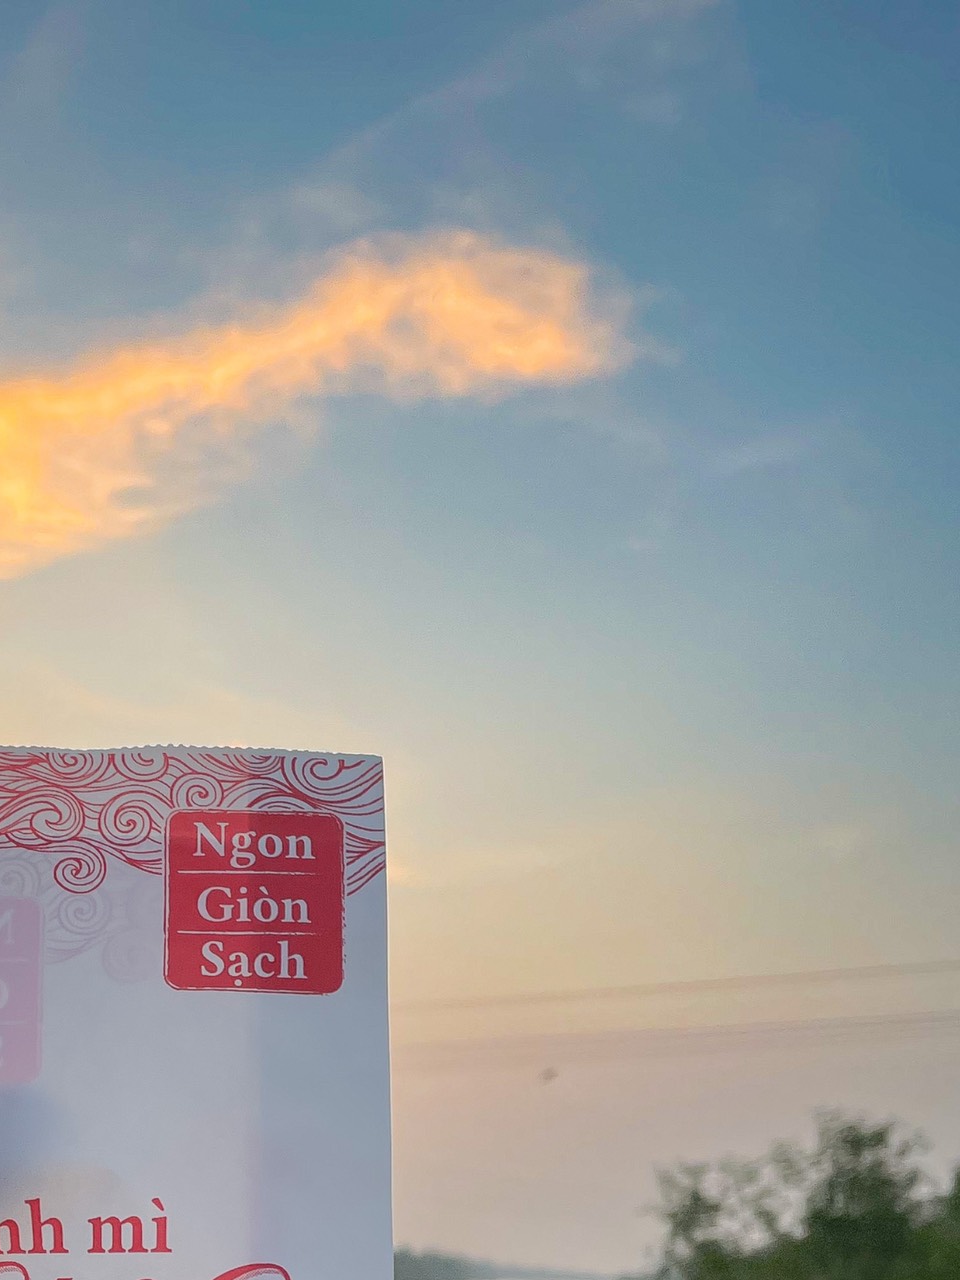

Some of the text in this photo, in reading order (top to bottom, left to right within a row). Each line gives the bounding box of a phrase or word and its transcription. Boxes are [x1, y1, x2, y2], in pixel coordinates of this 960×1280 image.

[193, 821, 316, 869] Ngon
[197, 886, 312, 924] Giòn
[200, 940, 308, 987] Sạch
[87, 1197, 173, 1254] mì
